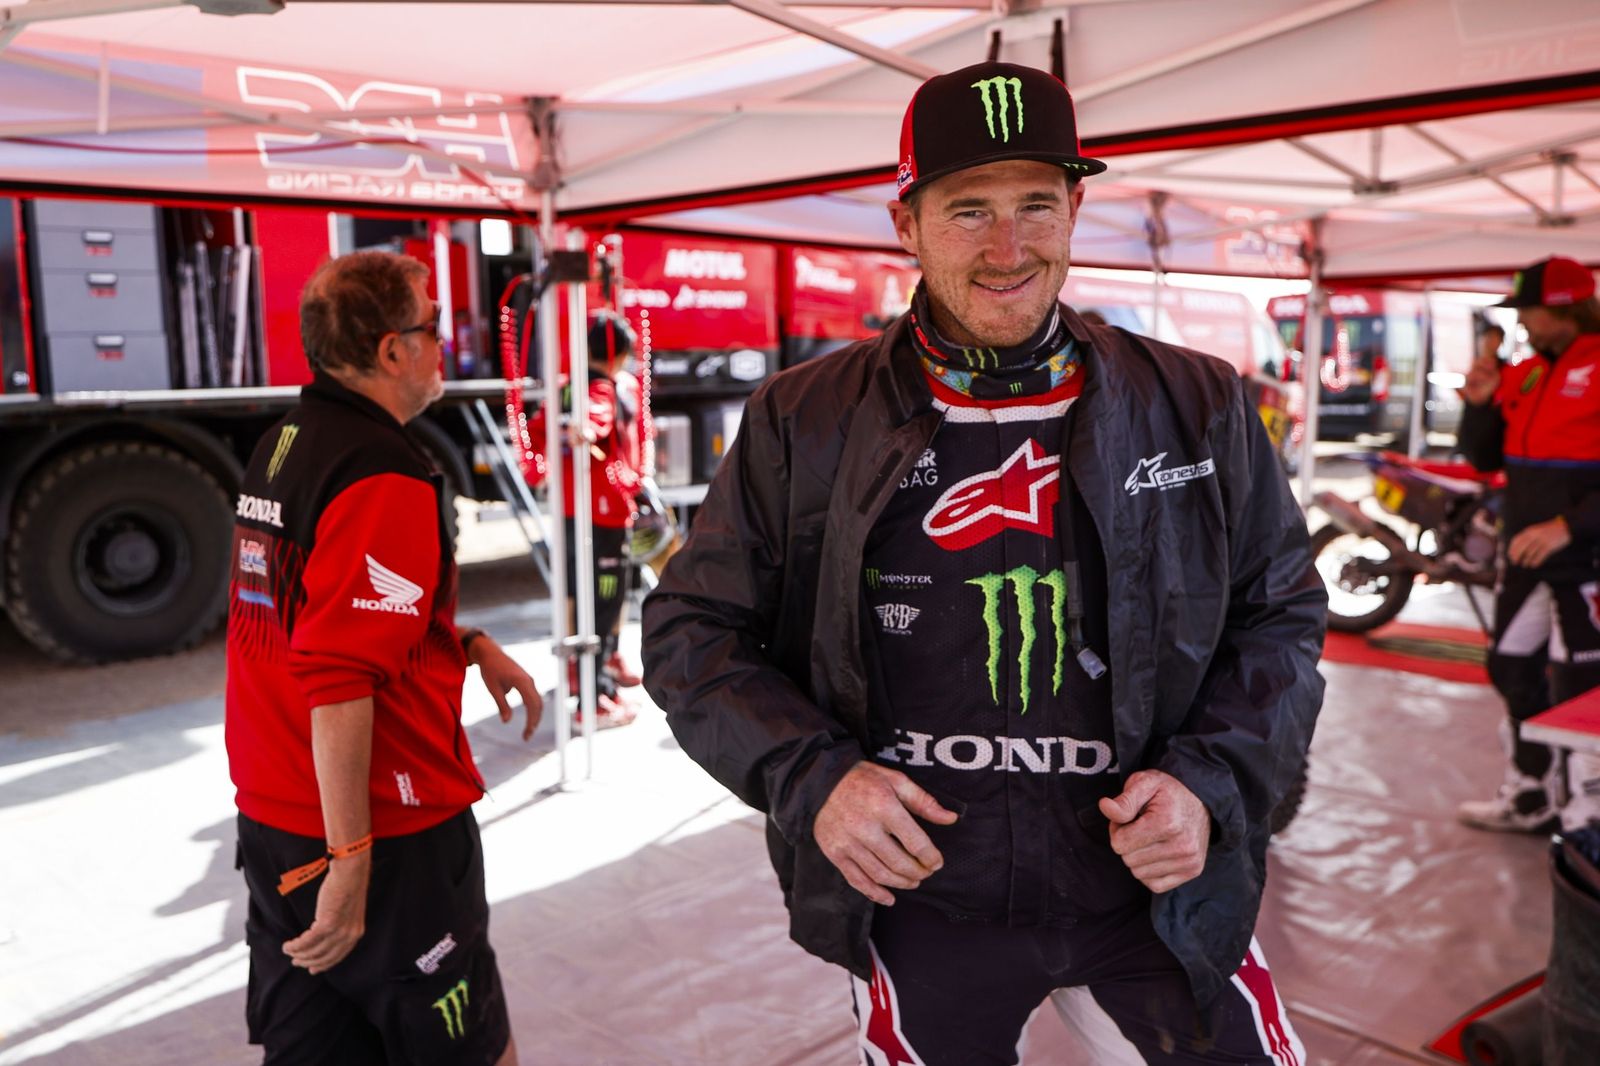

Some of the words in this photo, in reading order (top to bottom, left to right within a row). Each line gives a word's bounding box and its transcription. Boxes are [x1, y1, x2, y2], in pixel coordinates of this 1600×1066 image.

[664, 248, 747, 280] MOTUL
[879, 573, 933, 585] MONSTER
[352, 598, 419, 616] HONDA
[876, 729, 1120, 775] HOND
